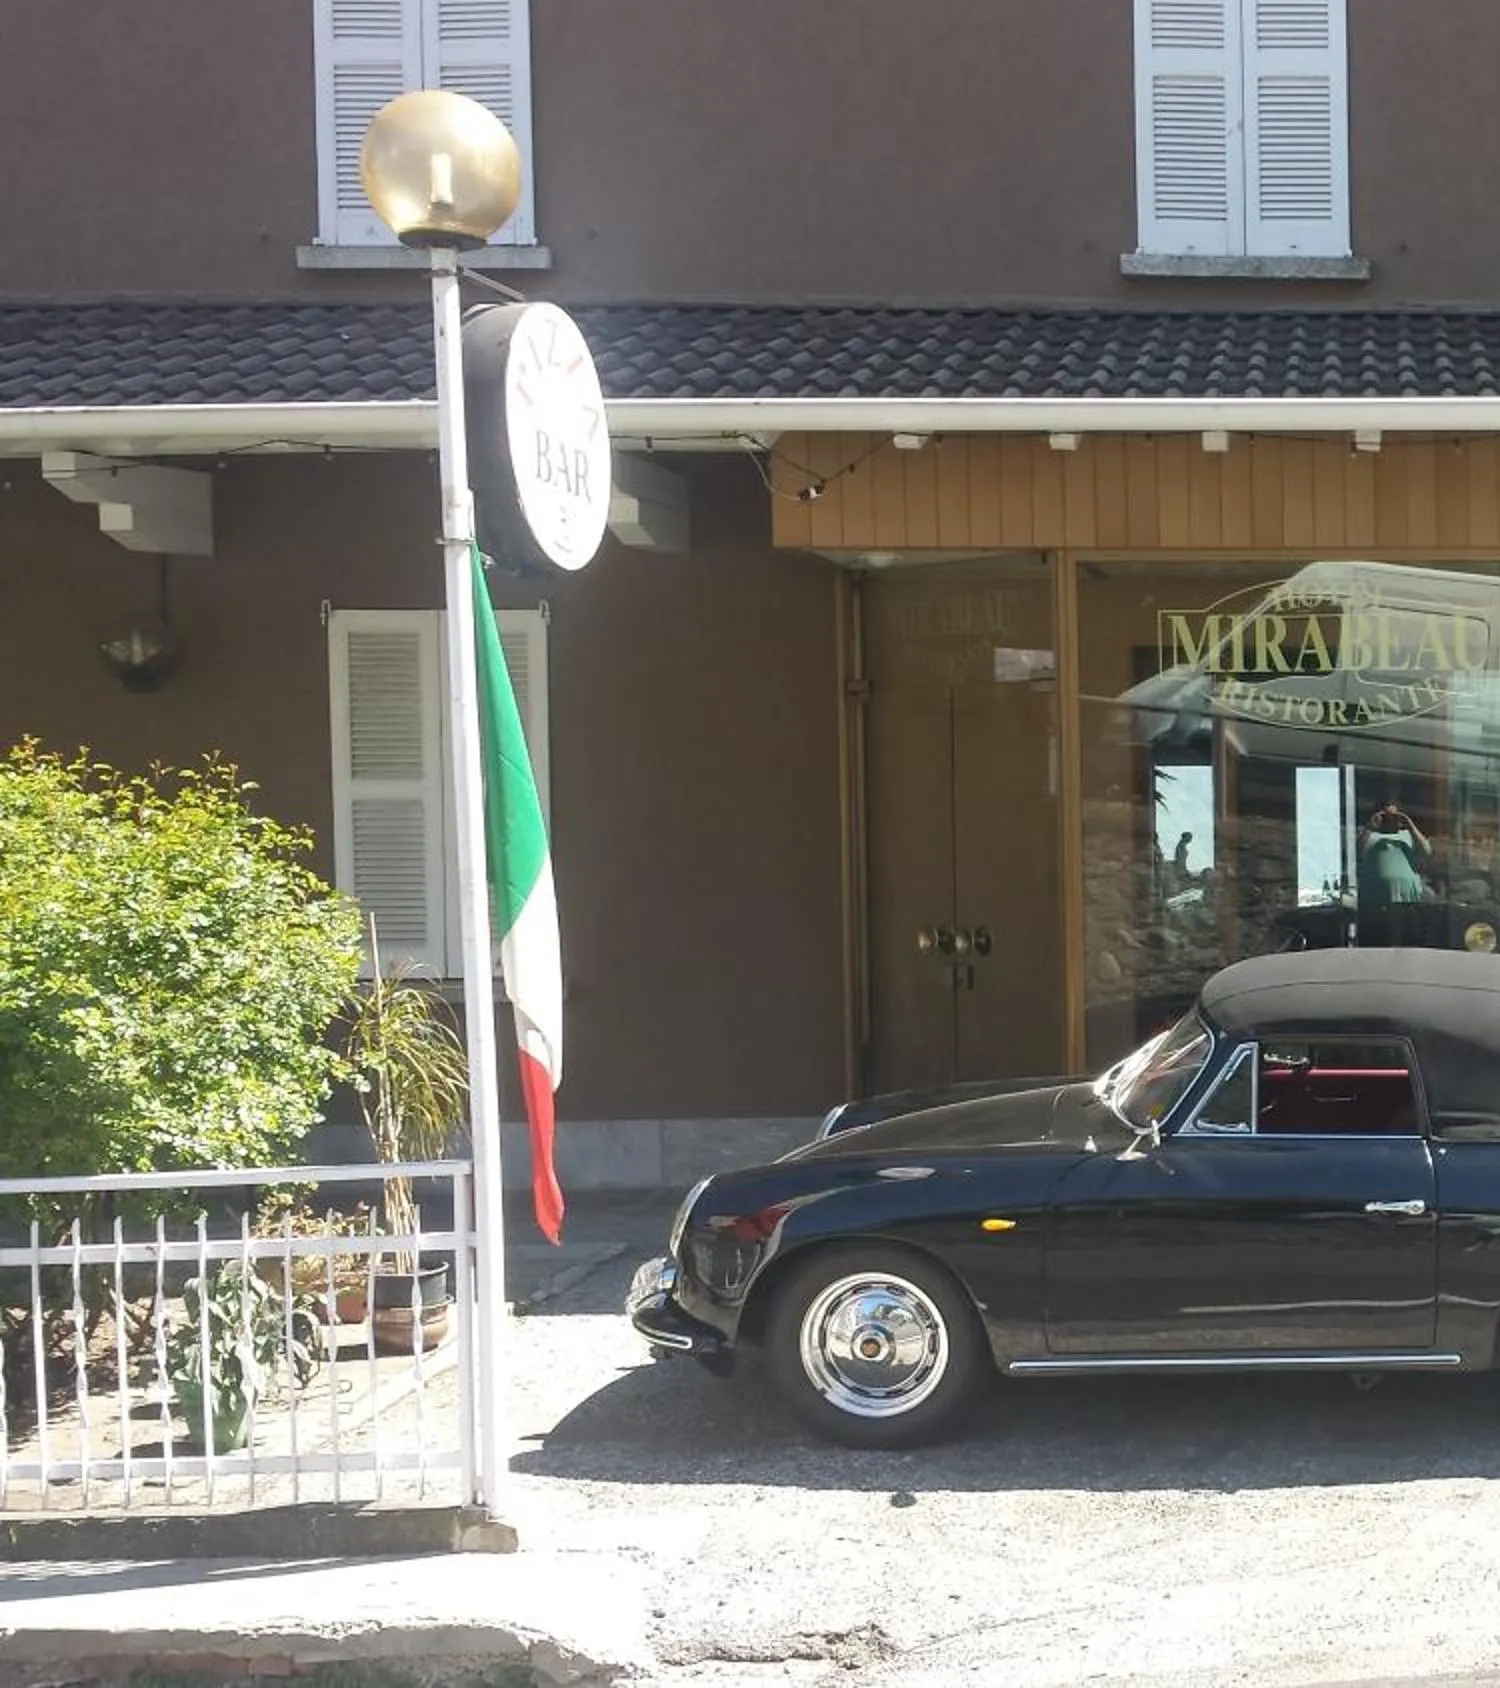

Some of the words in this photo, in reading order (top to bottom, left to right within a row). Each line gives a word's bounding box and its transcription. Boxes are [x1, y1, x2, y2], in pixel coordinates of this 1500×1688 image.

[535, 429, 592, 504] BAR
[1167, 612, 1488, 673] MIRABEAU
[1220, 674, 1449, 726] RISTORANTE
